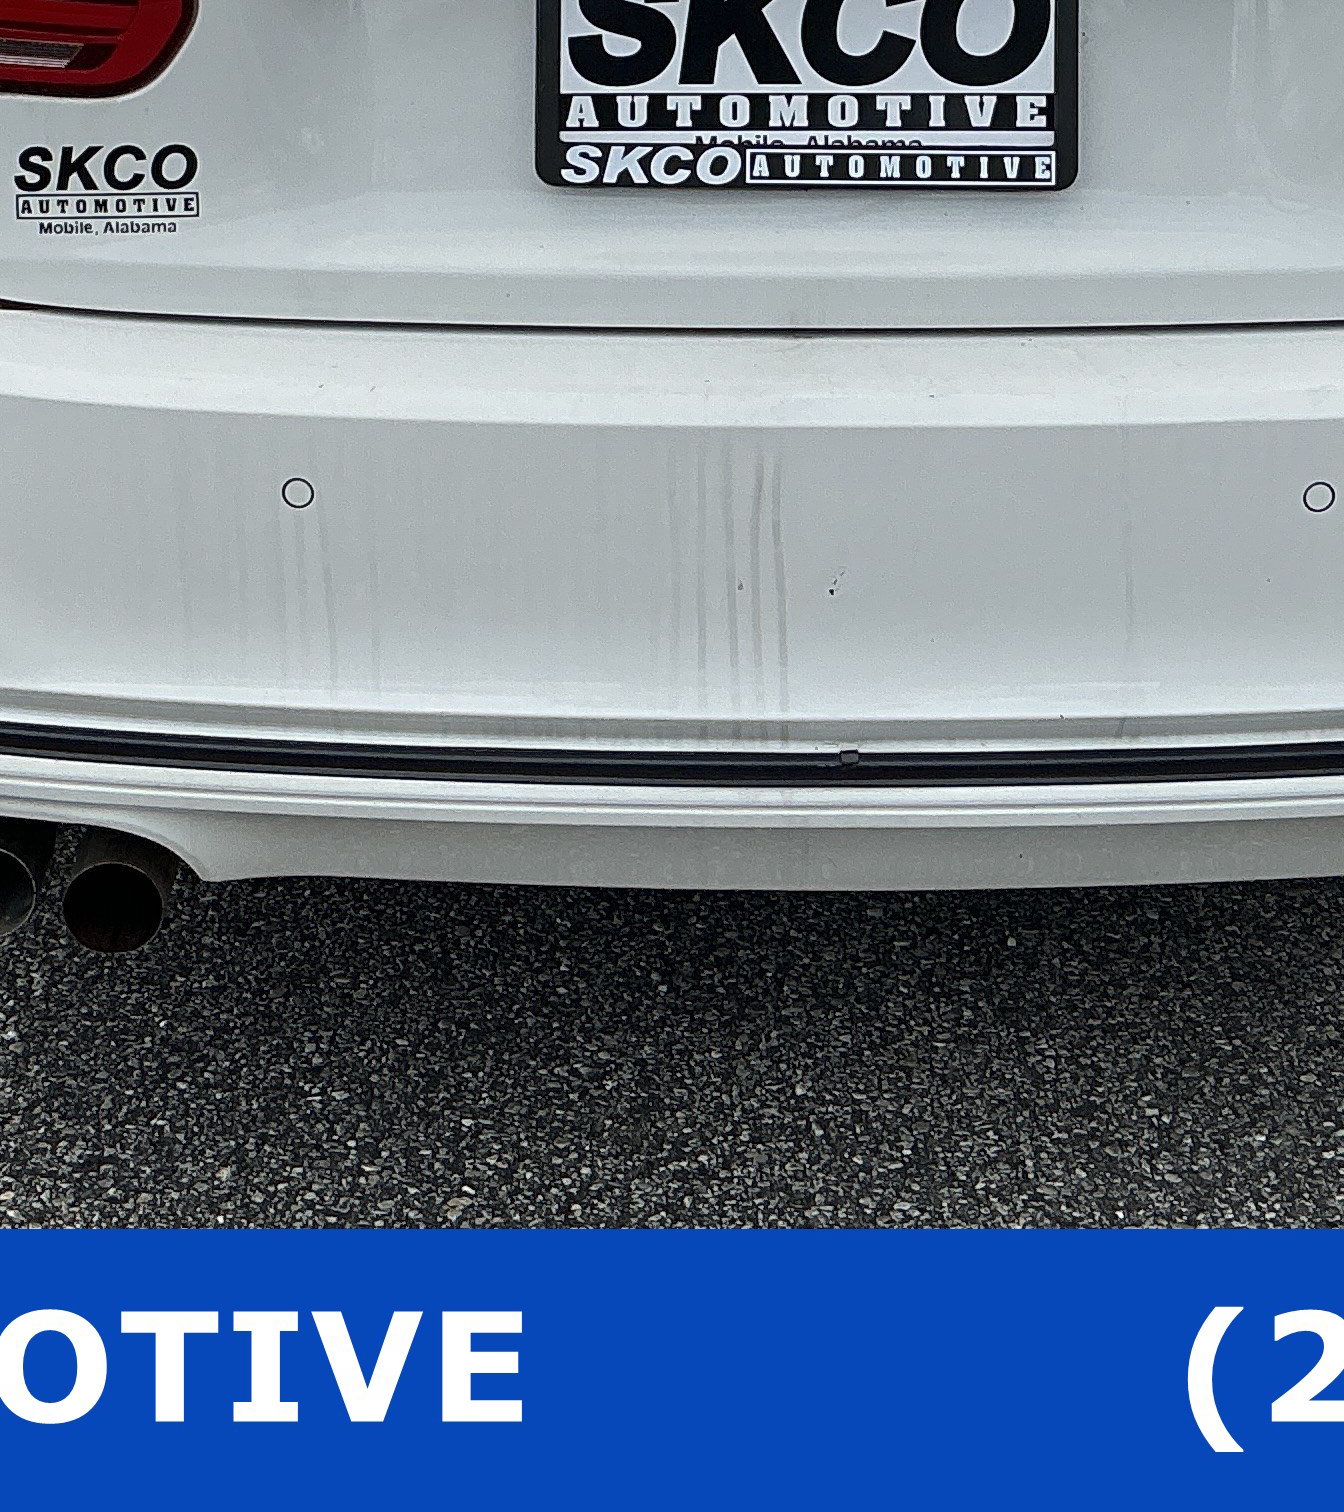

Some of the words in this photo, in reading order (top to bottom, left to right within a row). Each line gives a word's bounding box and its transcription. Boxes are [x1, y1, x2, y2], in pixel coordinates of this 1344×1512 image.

[566, 95, 1047, 128] AUTOMOTIVE
[14, 144, 198, 192] SKCO
[561, 145, 742, 185] SKCO
[753, 154, 1051, 179] AUTOMOTIVE
[21, 197, 196, 215] AUTOMOTIVE
[39, 222, 99, 236] Mobile,
[103, 221, 177, 235] Alabama
